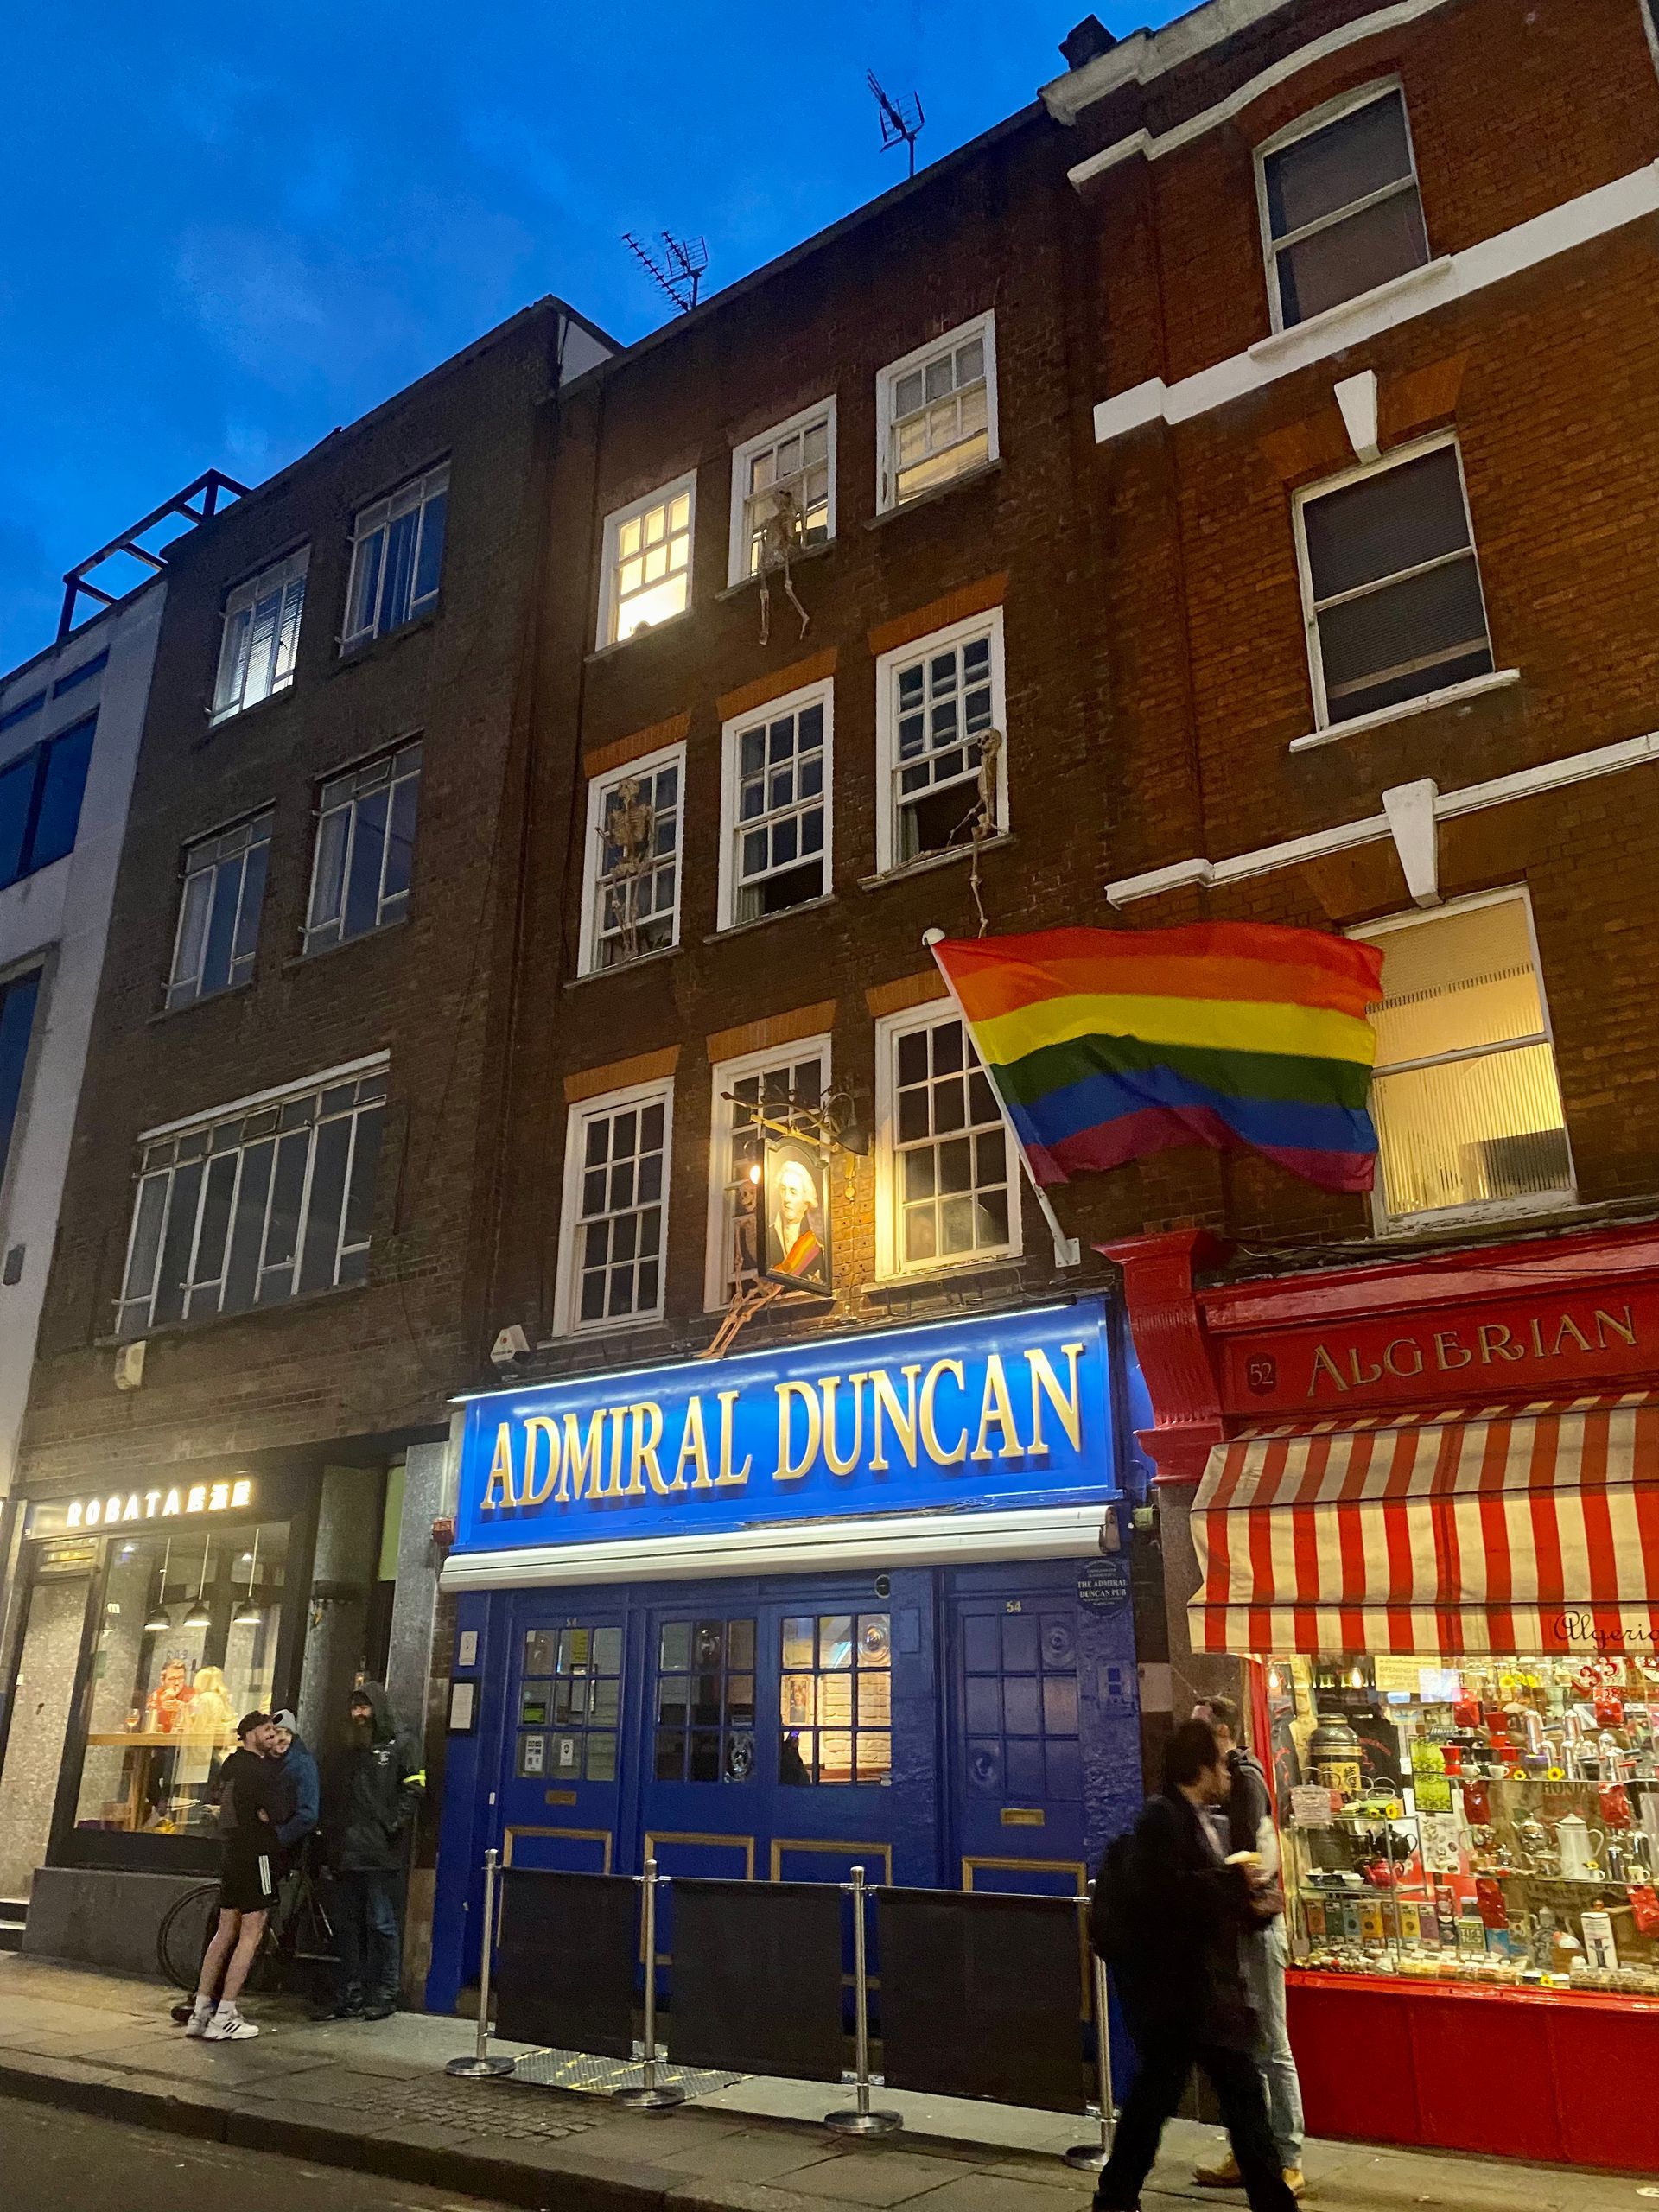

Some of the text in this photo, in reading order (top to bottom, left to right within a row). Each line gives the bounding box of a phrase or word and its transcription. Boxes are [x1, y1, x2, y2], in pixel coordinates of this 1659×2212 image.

[1306, 1306, 1639, 1397] ALGERIAN
[1249, 1363, 1274, 1387] 52
[480, 1342, 1087, 1510] ADMIRAL DUNCAN
[67, 1488, 180, 1528] ROBATA
[1093, 1579, 1127, 1587] ADMIRAL
[1006, 1600, 1022, 1613] 54
